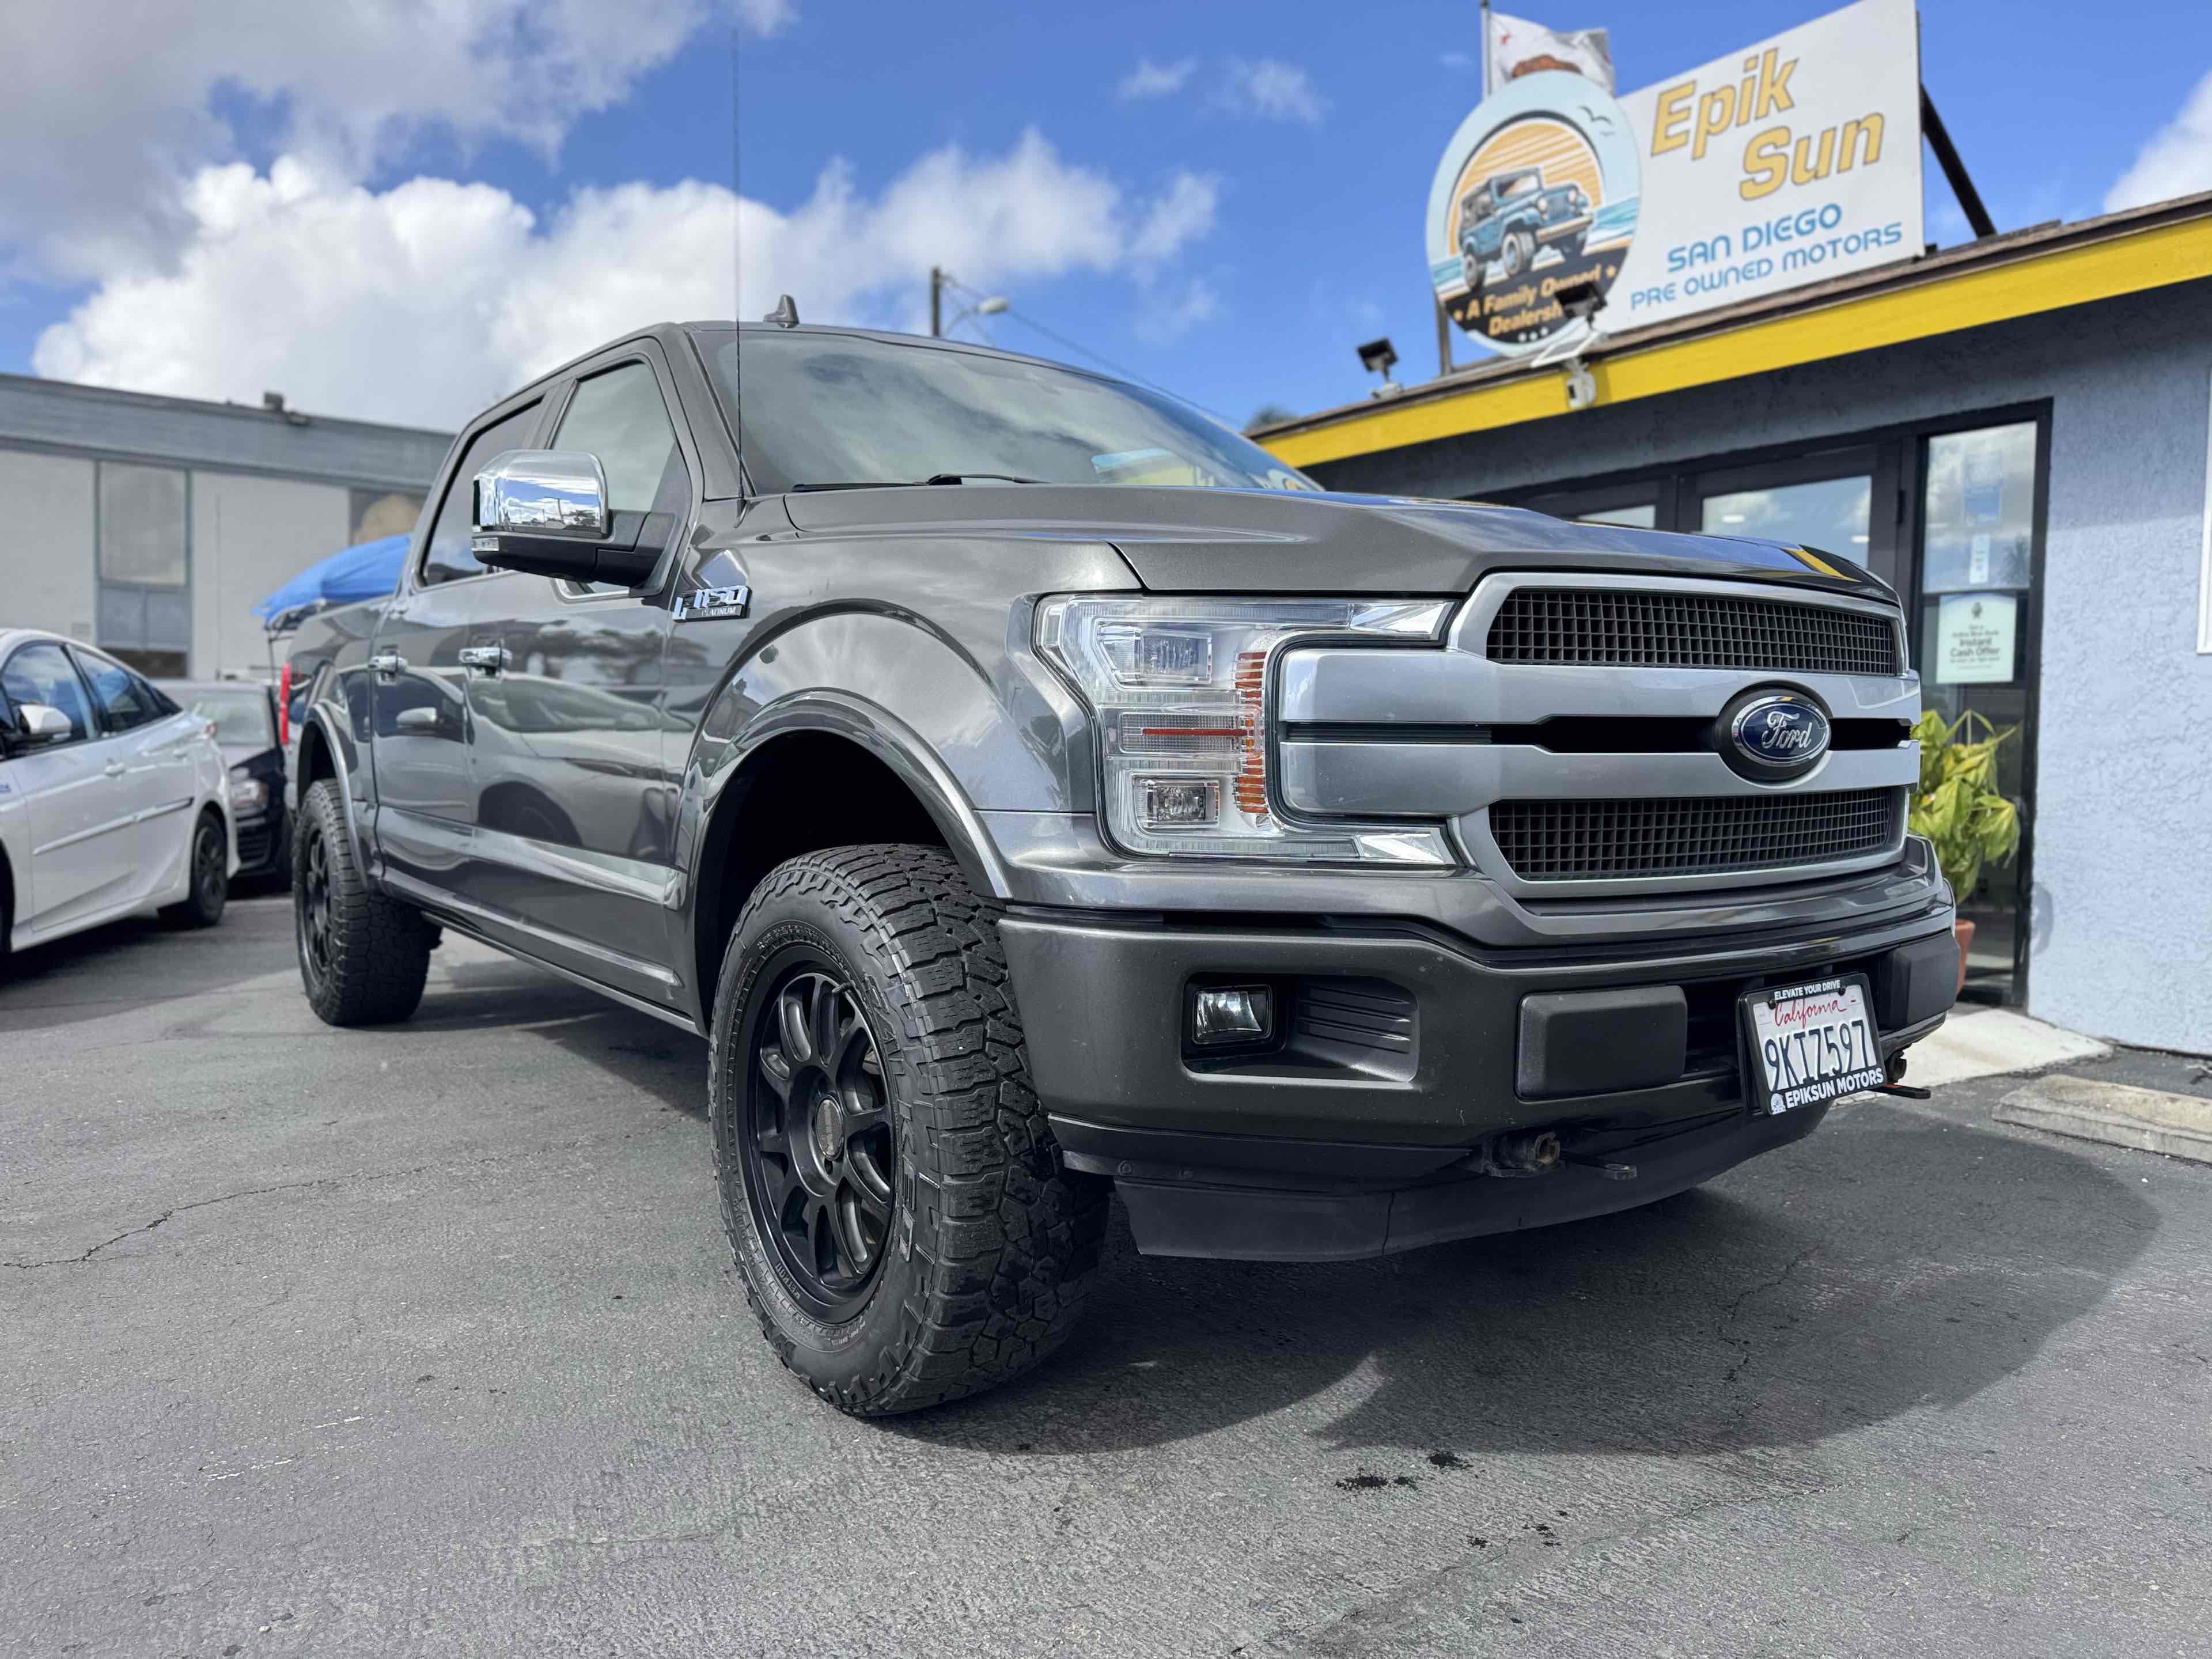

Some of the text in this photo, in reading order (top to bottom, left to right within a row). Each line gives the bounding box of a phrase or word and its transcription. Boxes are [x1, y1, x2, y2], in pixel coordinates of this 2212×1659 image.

[1650, 47, 1800, 161] Epik
[1739, 112, 1885, 201] Sun
[1667, 202, 1843, 273] SAN DIEGO
[1631, 222, 1903, 310] PRE OWNED MOTORS
[1465, 299, 1481, 320] A
[1483, 285, 1538, 315] Family
[1488, 299, 1564, 336] Dealersh
[701, 607, 737, 617] PLATINUM
[1762, 711, 1812, 749] Ford
[1774, 979, 1841, 1001] ELEVATE YOUR DRIVE
[1774, 998, 1847, 1029] California
[1764, 1019, 1869, 1092] 9KIZ597
[1785, 1067, 1884, 1108] EPIKSUN MOTORS
